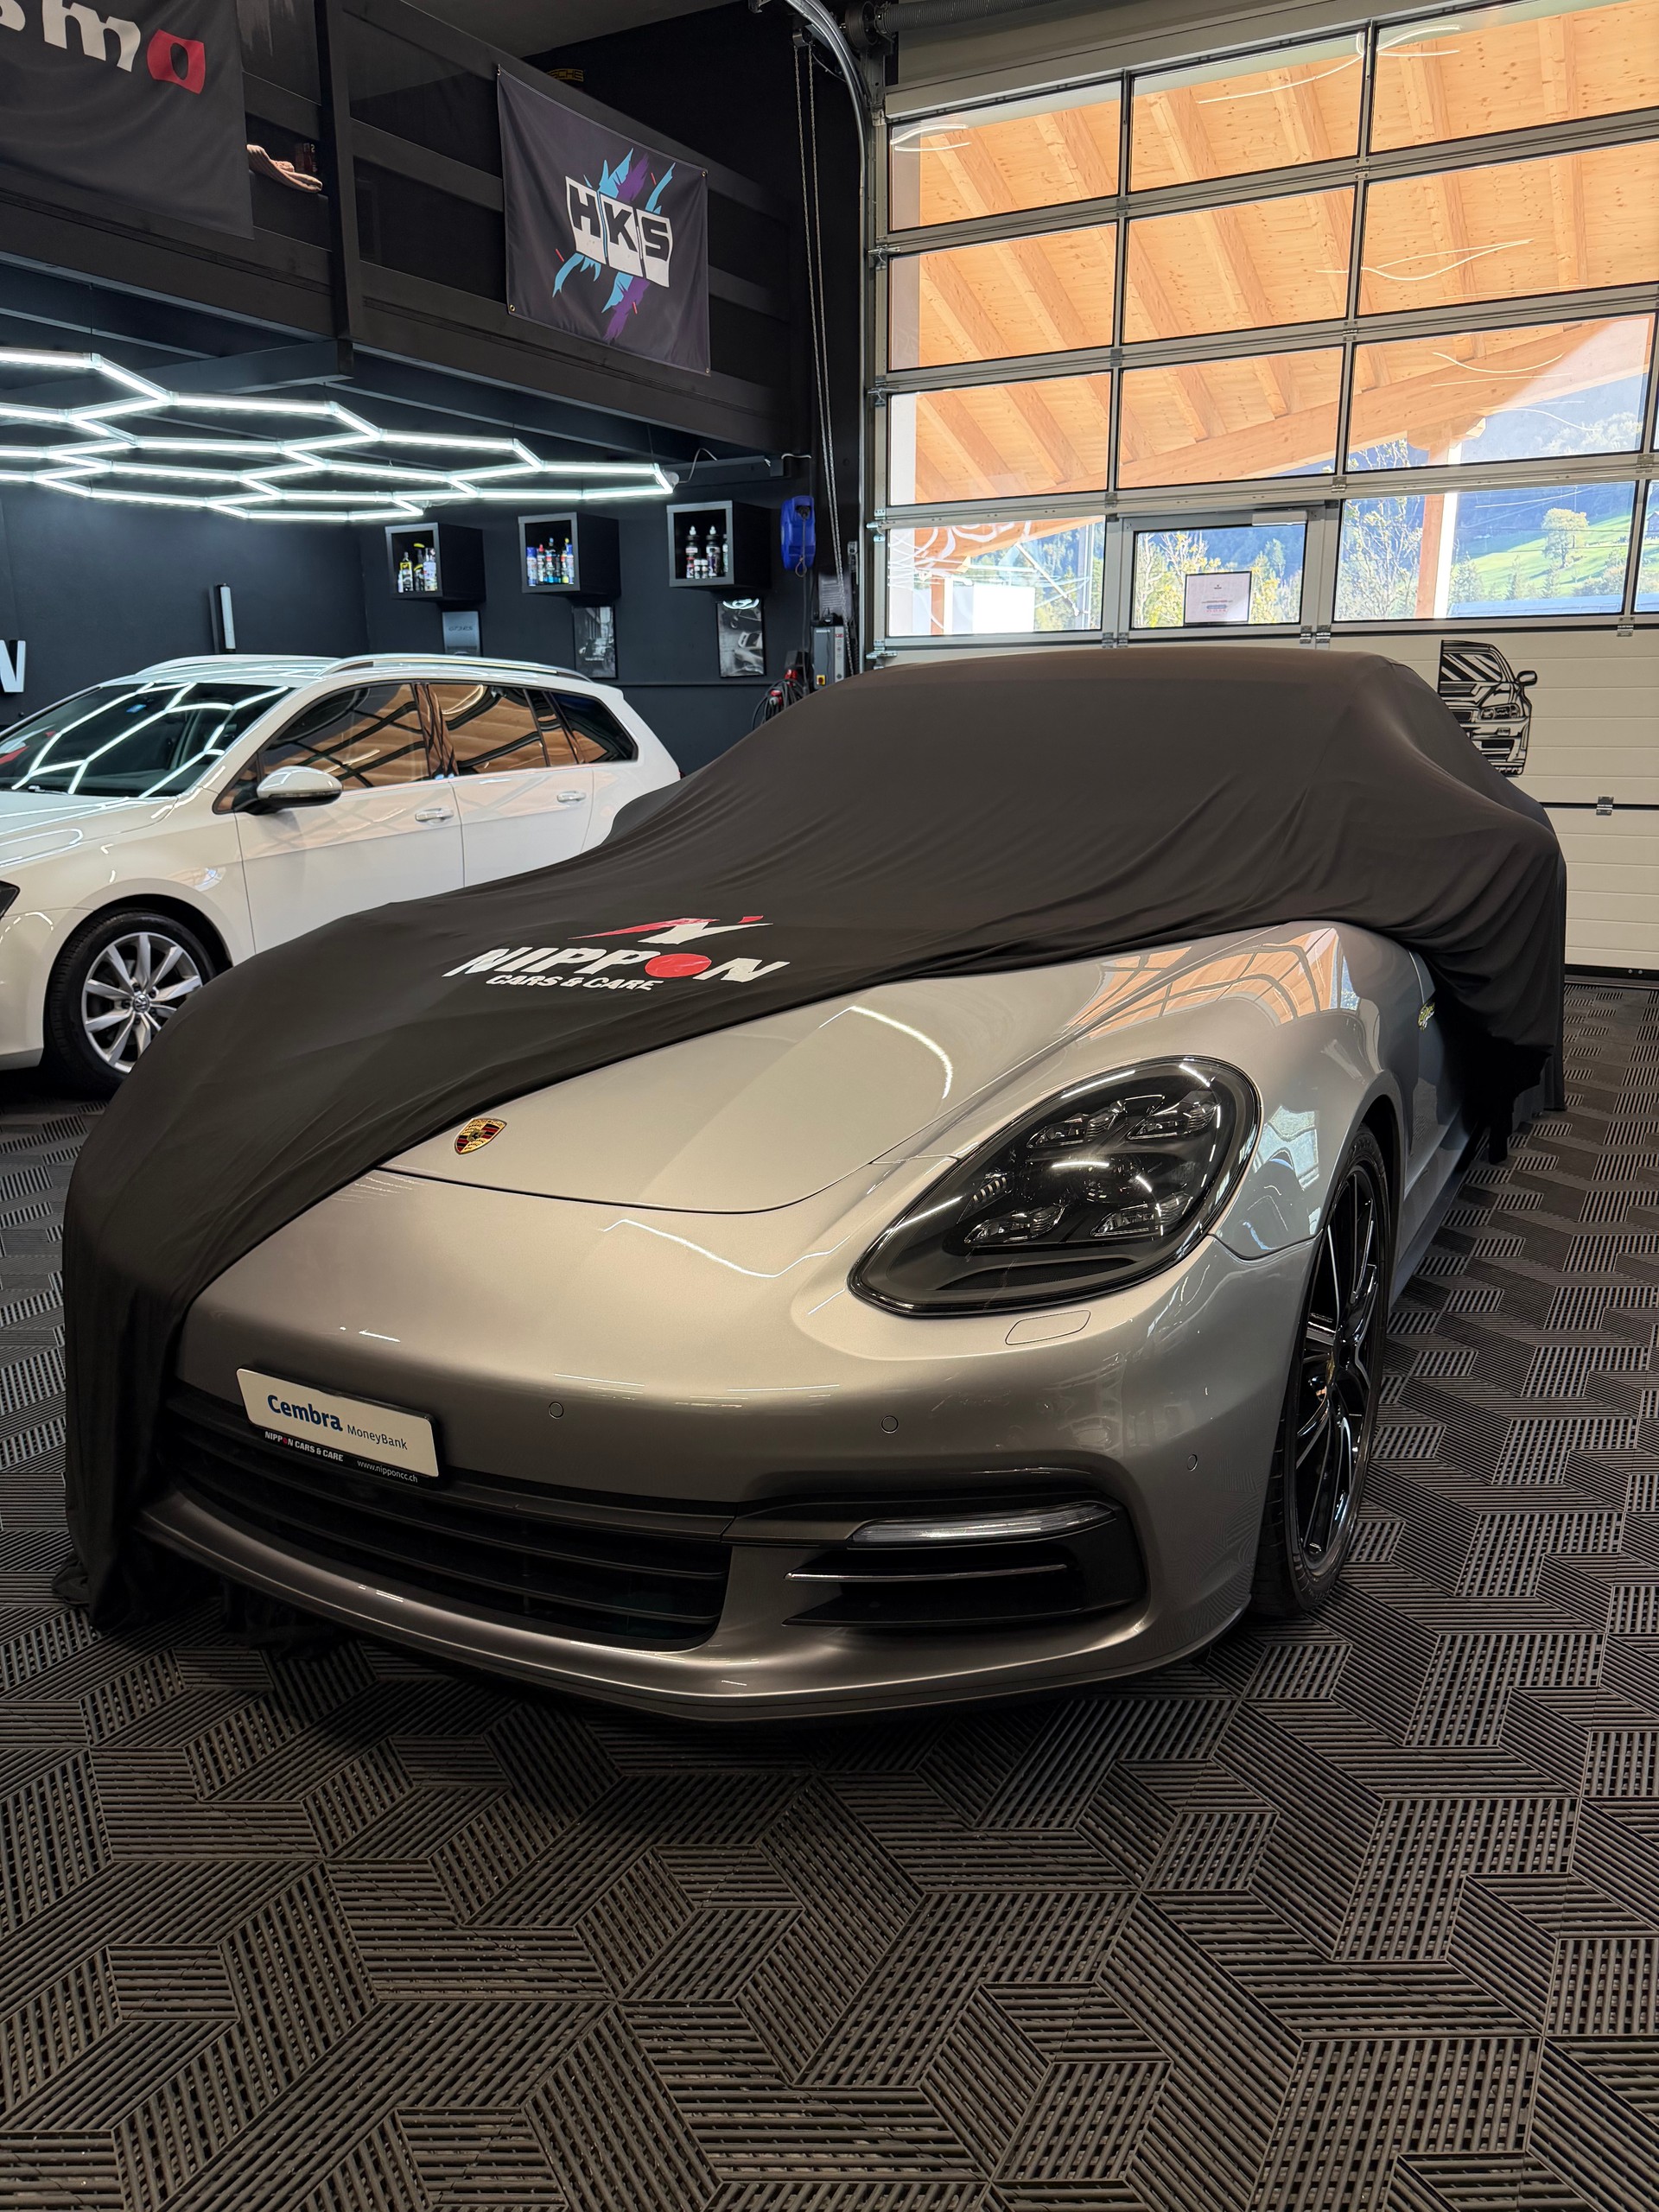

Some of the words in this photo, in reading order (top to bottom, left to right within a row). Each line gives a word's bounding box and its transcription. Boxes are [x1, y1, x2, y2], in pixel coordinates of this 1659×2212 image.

[569, 183, 671, 262] HKS
[442, 947, 790, 983] NIPPON
[486, 975, 560, 988] CARS
[560, 976, 580, 988] &
[582, 976, 664, 991] CARE
[267, 1395, 343, 1432] Cembra
[346, 1424, 408, 1451] MoneyBank
[264, 1431, 294, 1447] NIPPON
[295, 1440, 315, 1453] CARS
[322, 1449, 344, 1462] CARE
[357, 1460, 418, 1484] www.nipponcc.ch
